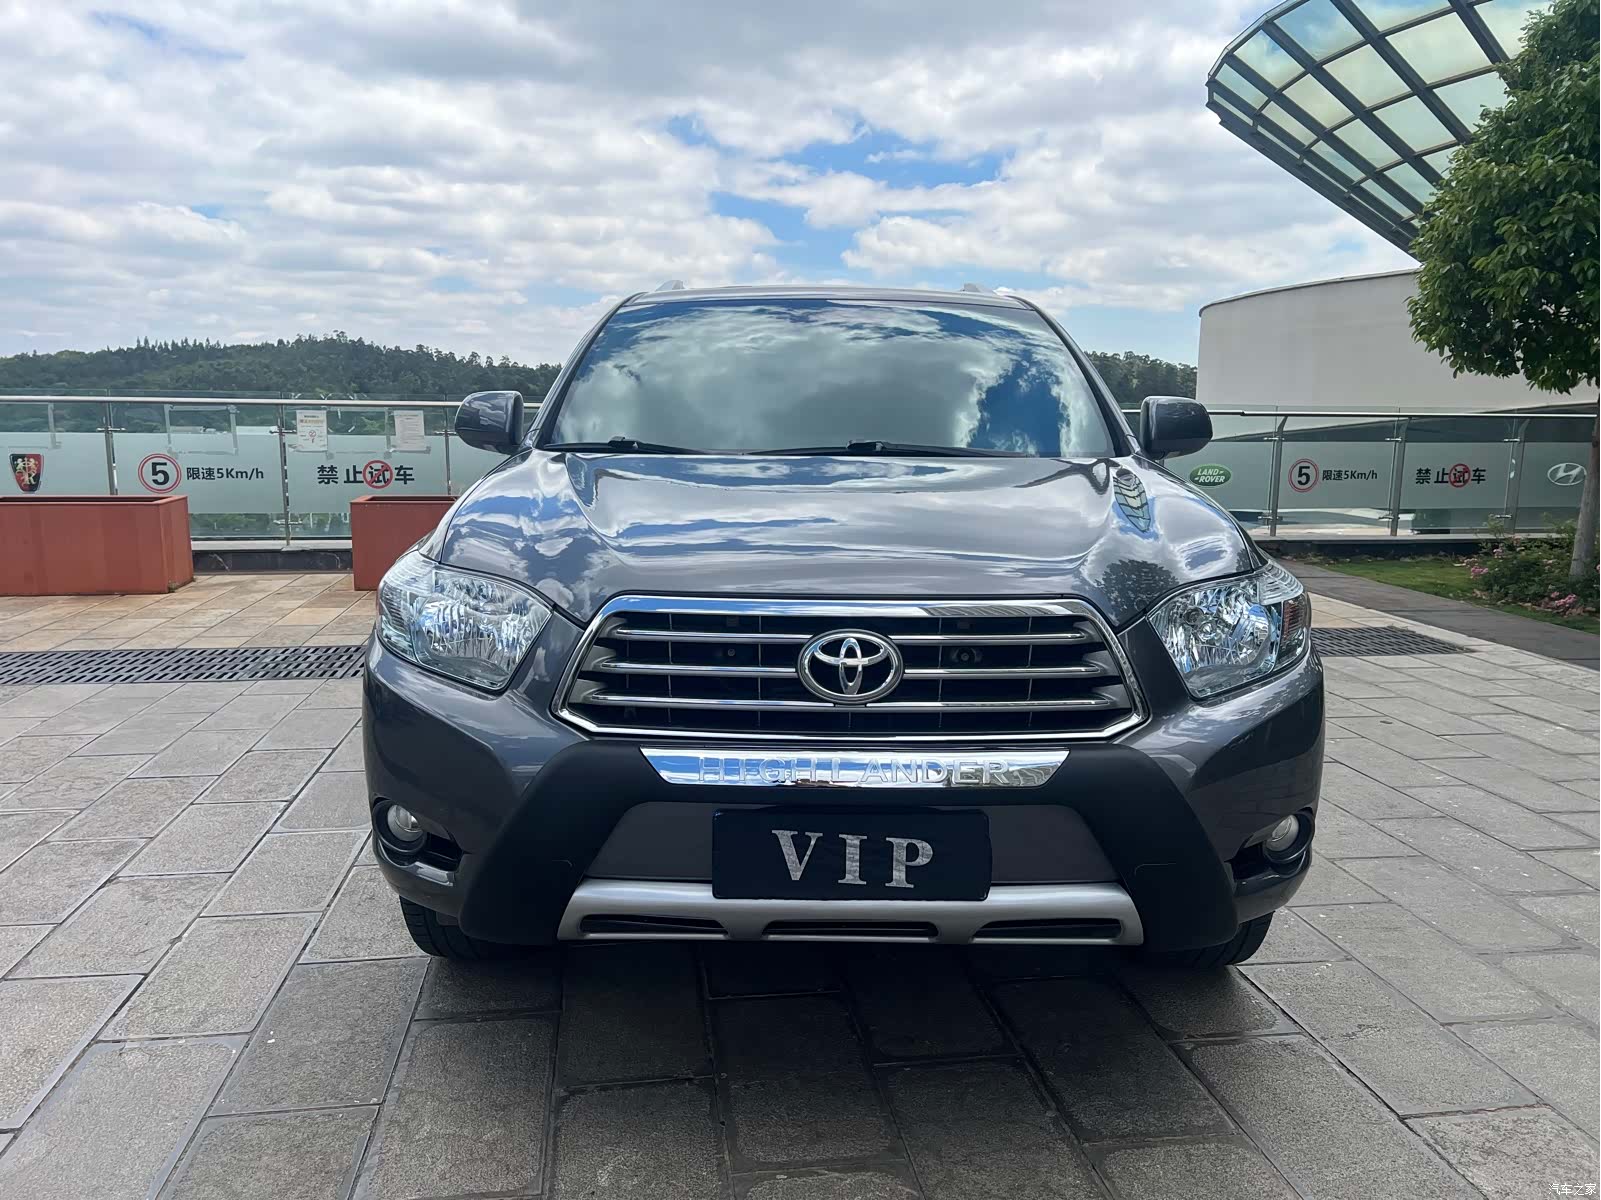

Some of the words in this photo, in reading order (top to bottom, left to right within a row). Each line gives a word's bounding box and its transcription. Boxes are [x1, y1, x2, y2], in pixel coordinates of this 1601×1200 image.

[151, 462, 170, 485] 5
[186, 467, 264, 480] 限速5Km/h
[317, 464, 415, 485] 禁止试车
[1197, 468, 1219, 476] LAND
[1199, 475, 1225, 483] ROVER
[1297, 466, 1310, 485] 5
[1322, 470, 1378, 481] 限速5Km/h
[1415, 467, 1486, 484] 禁止试车
[698, 757, 1009, 785] HIGHLANDER
[771, 829, 934, 889] VIP
